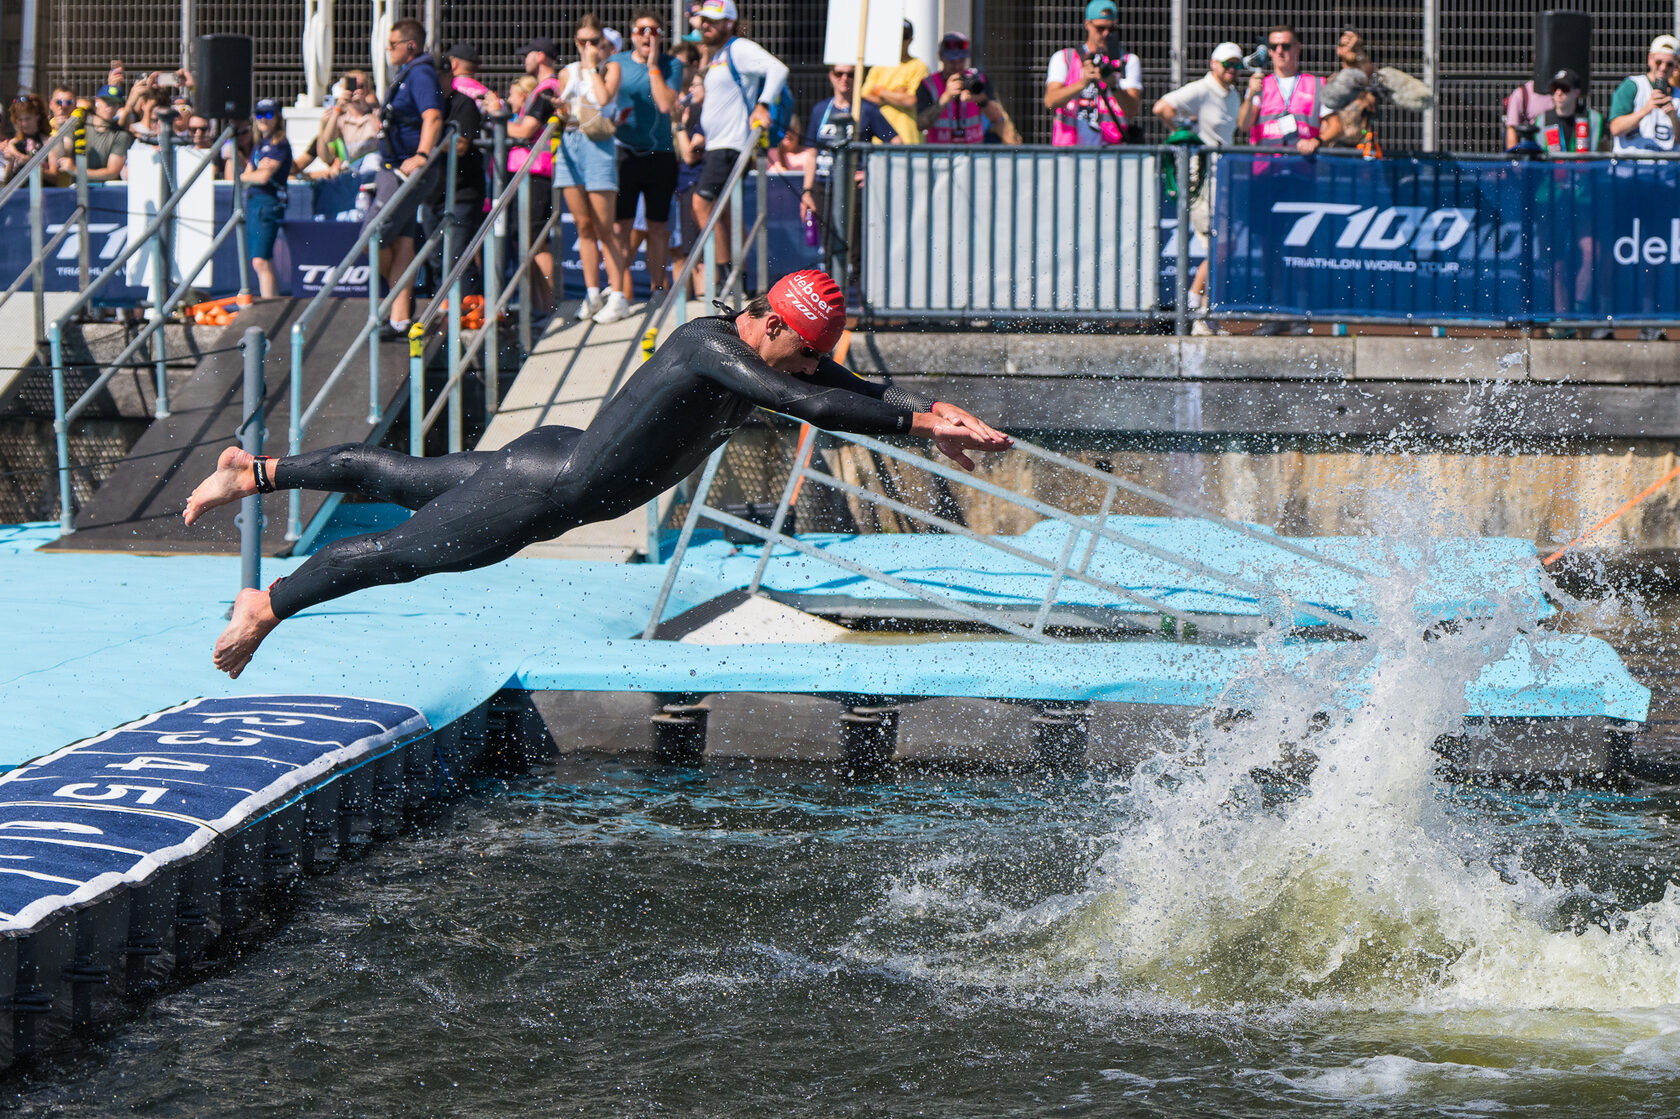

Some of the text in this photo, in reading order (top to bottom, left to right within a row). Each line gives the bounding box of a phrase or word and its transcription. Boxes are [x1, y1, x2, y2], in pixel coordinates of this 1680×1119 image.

[1271, 202, 1477, 250] T100
[1283, 256, 1460, 272] TRIATHLON WORLD TOUR
[793, 274, 833, 314] deboer
[784, 288, 819, 321] T100
[202, 716, 306, 727] 2
[156, 733, 263, 747] 3
[104, 755, 211, 773] 4
[52, 782, 170, 805] 5
